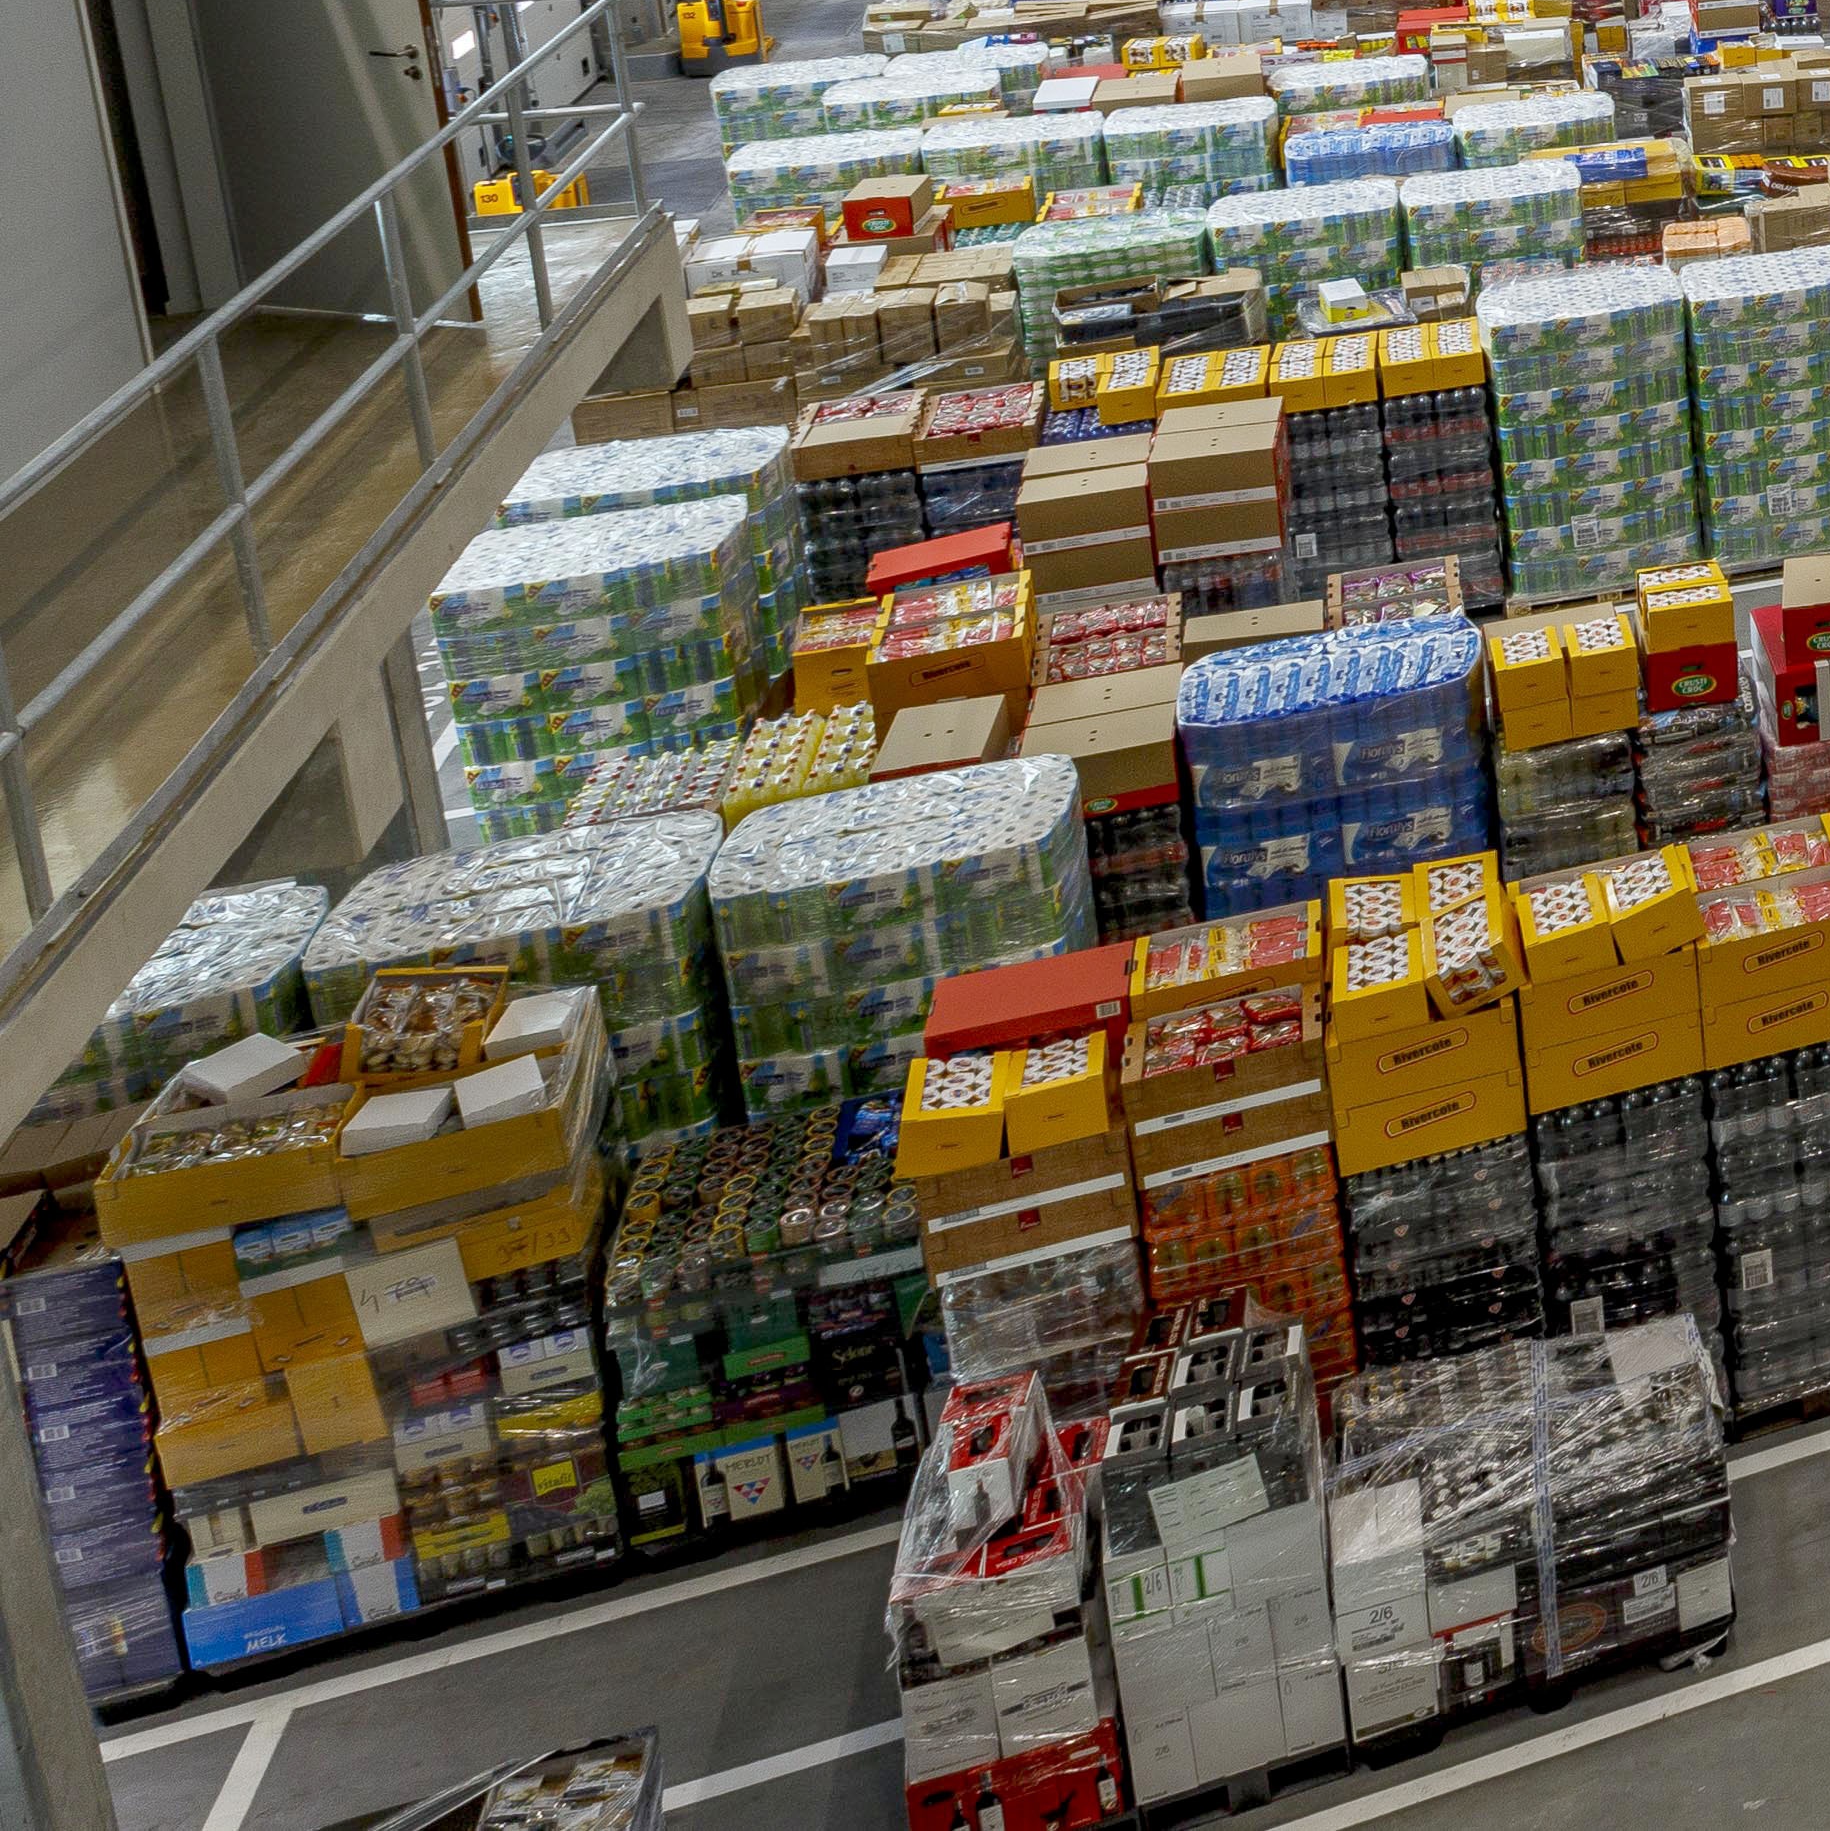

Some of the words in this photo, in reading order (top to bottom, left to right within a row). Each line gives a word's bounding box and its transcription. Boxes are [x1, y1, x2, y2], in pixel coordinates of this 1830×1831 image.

[1677, 676, 1710, 689] CRUSTI
[1684, 684, 1704, 695] CROC
[1757, 939, 1810, 966] Rivercote
[1582, 978, 1639, 1006] Rivercote
[1762, 999, 1814, 1026] Rivercote
[1393, 1038, 1452, 1066] Rivercote
[1588, 1040, 1644, 1068] Rivercote
[1400, 1100, 1460, 1131] Rivercote
[725, 1454, 770, 1472] MERLOT
[1143, 1571, 1163, 1597] 2/6
[1640, 1572, 1659, 1588] 2/6
[1369, 1606, 1394, 1627] 2/6
[246, 1634, 287, 1653] MELK
